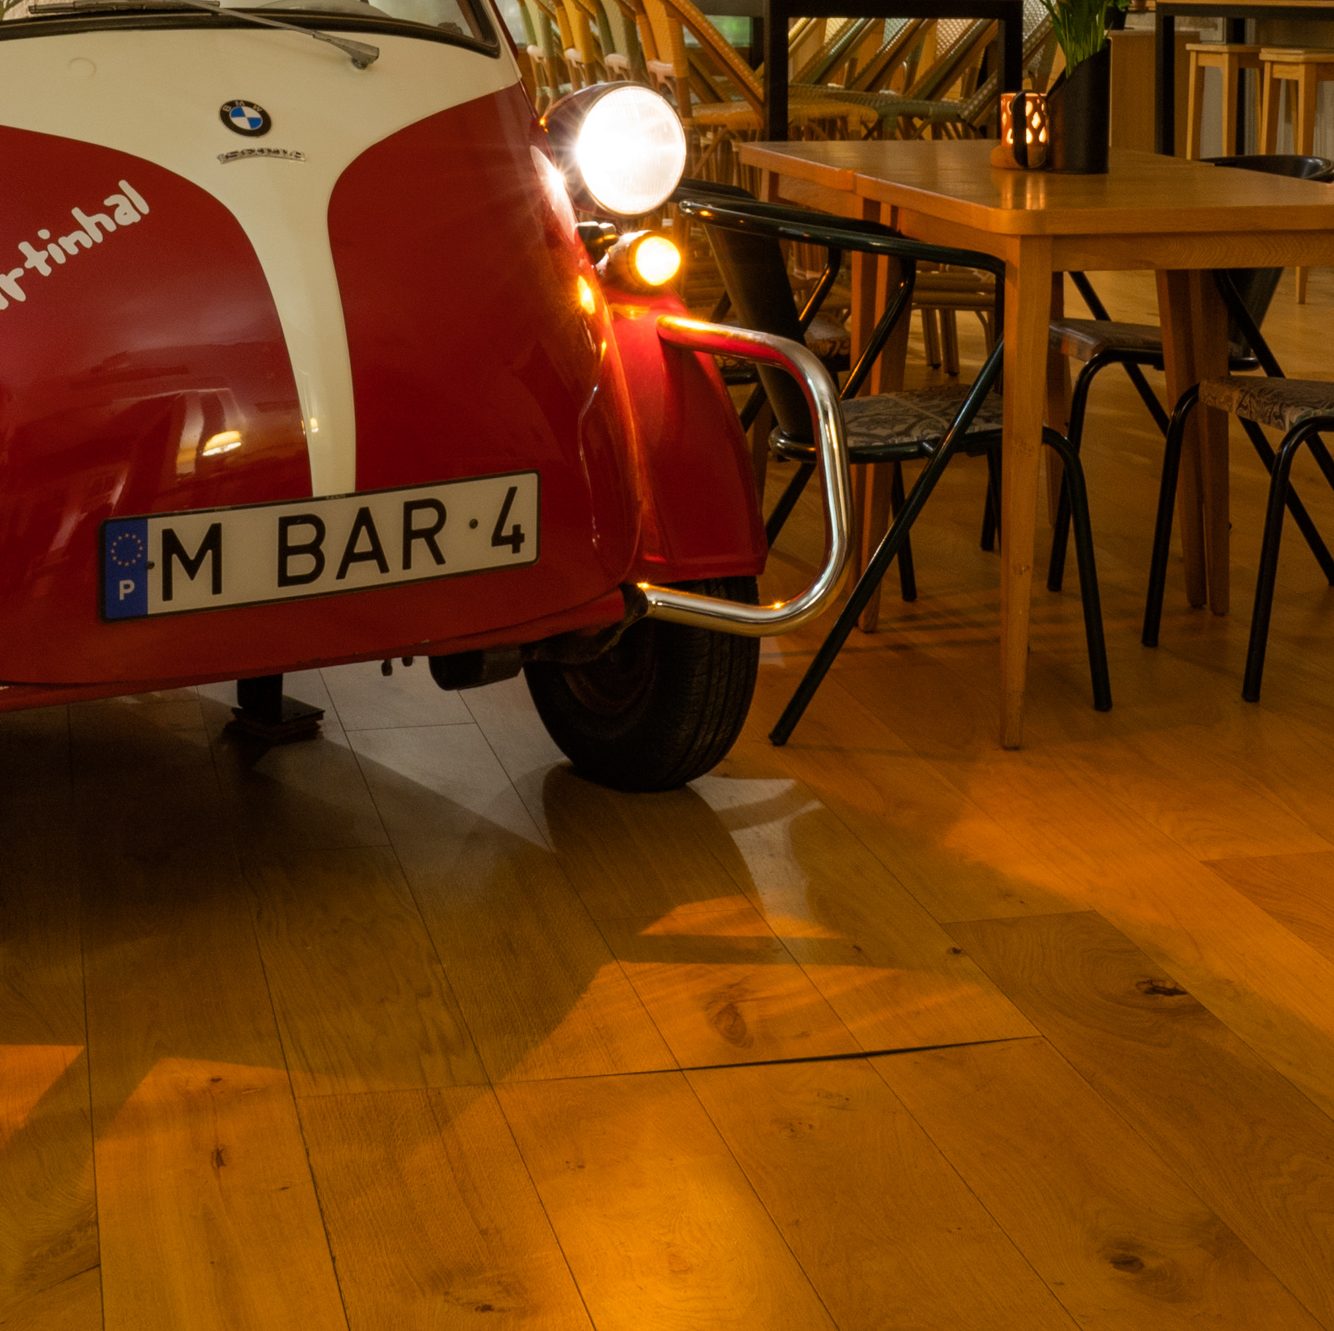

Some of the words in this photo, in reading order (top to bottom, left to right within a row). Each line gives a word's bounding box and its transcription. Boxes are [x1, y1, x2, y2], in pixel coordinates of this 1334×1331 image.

[222, 100, 263, 112] BMW
[161, 522, 223, 602] M
[277, 497, 446, 588] BAR
[491, 485, 526, 554] 4
[118, 579, 135, 601] P
